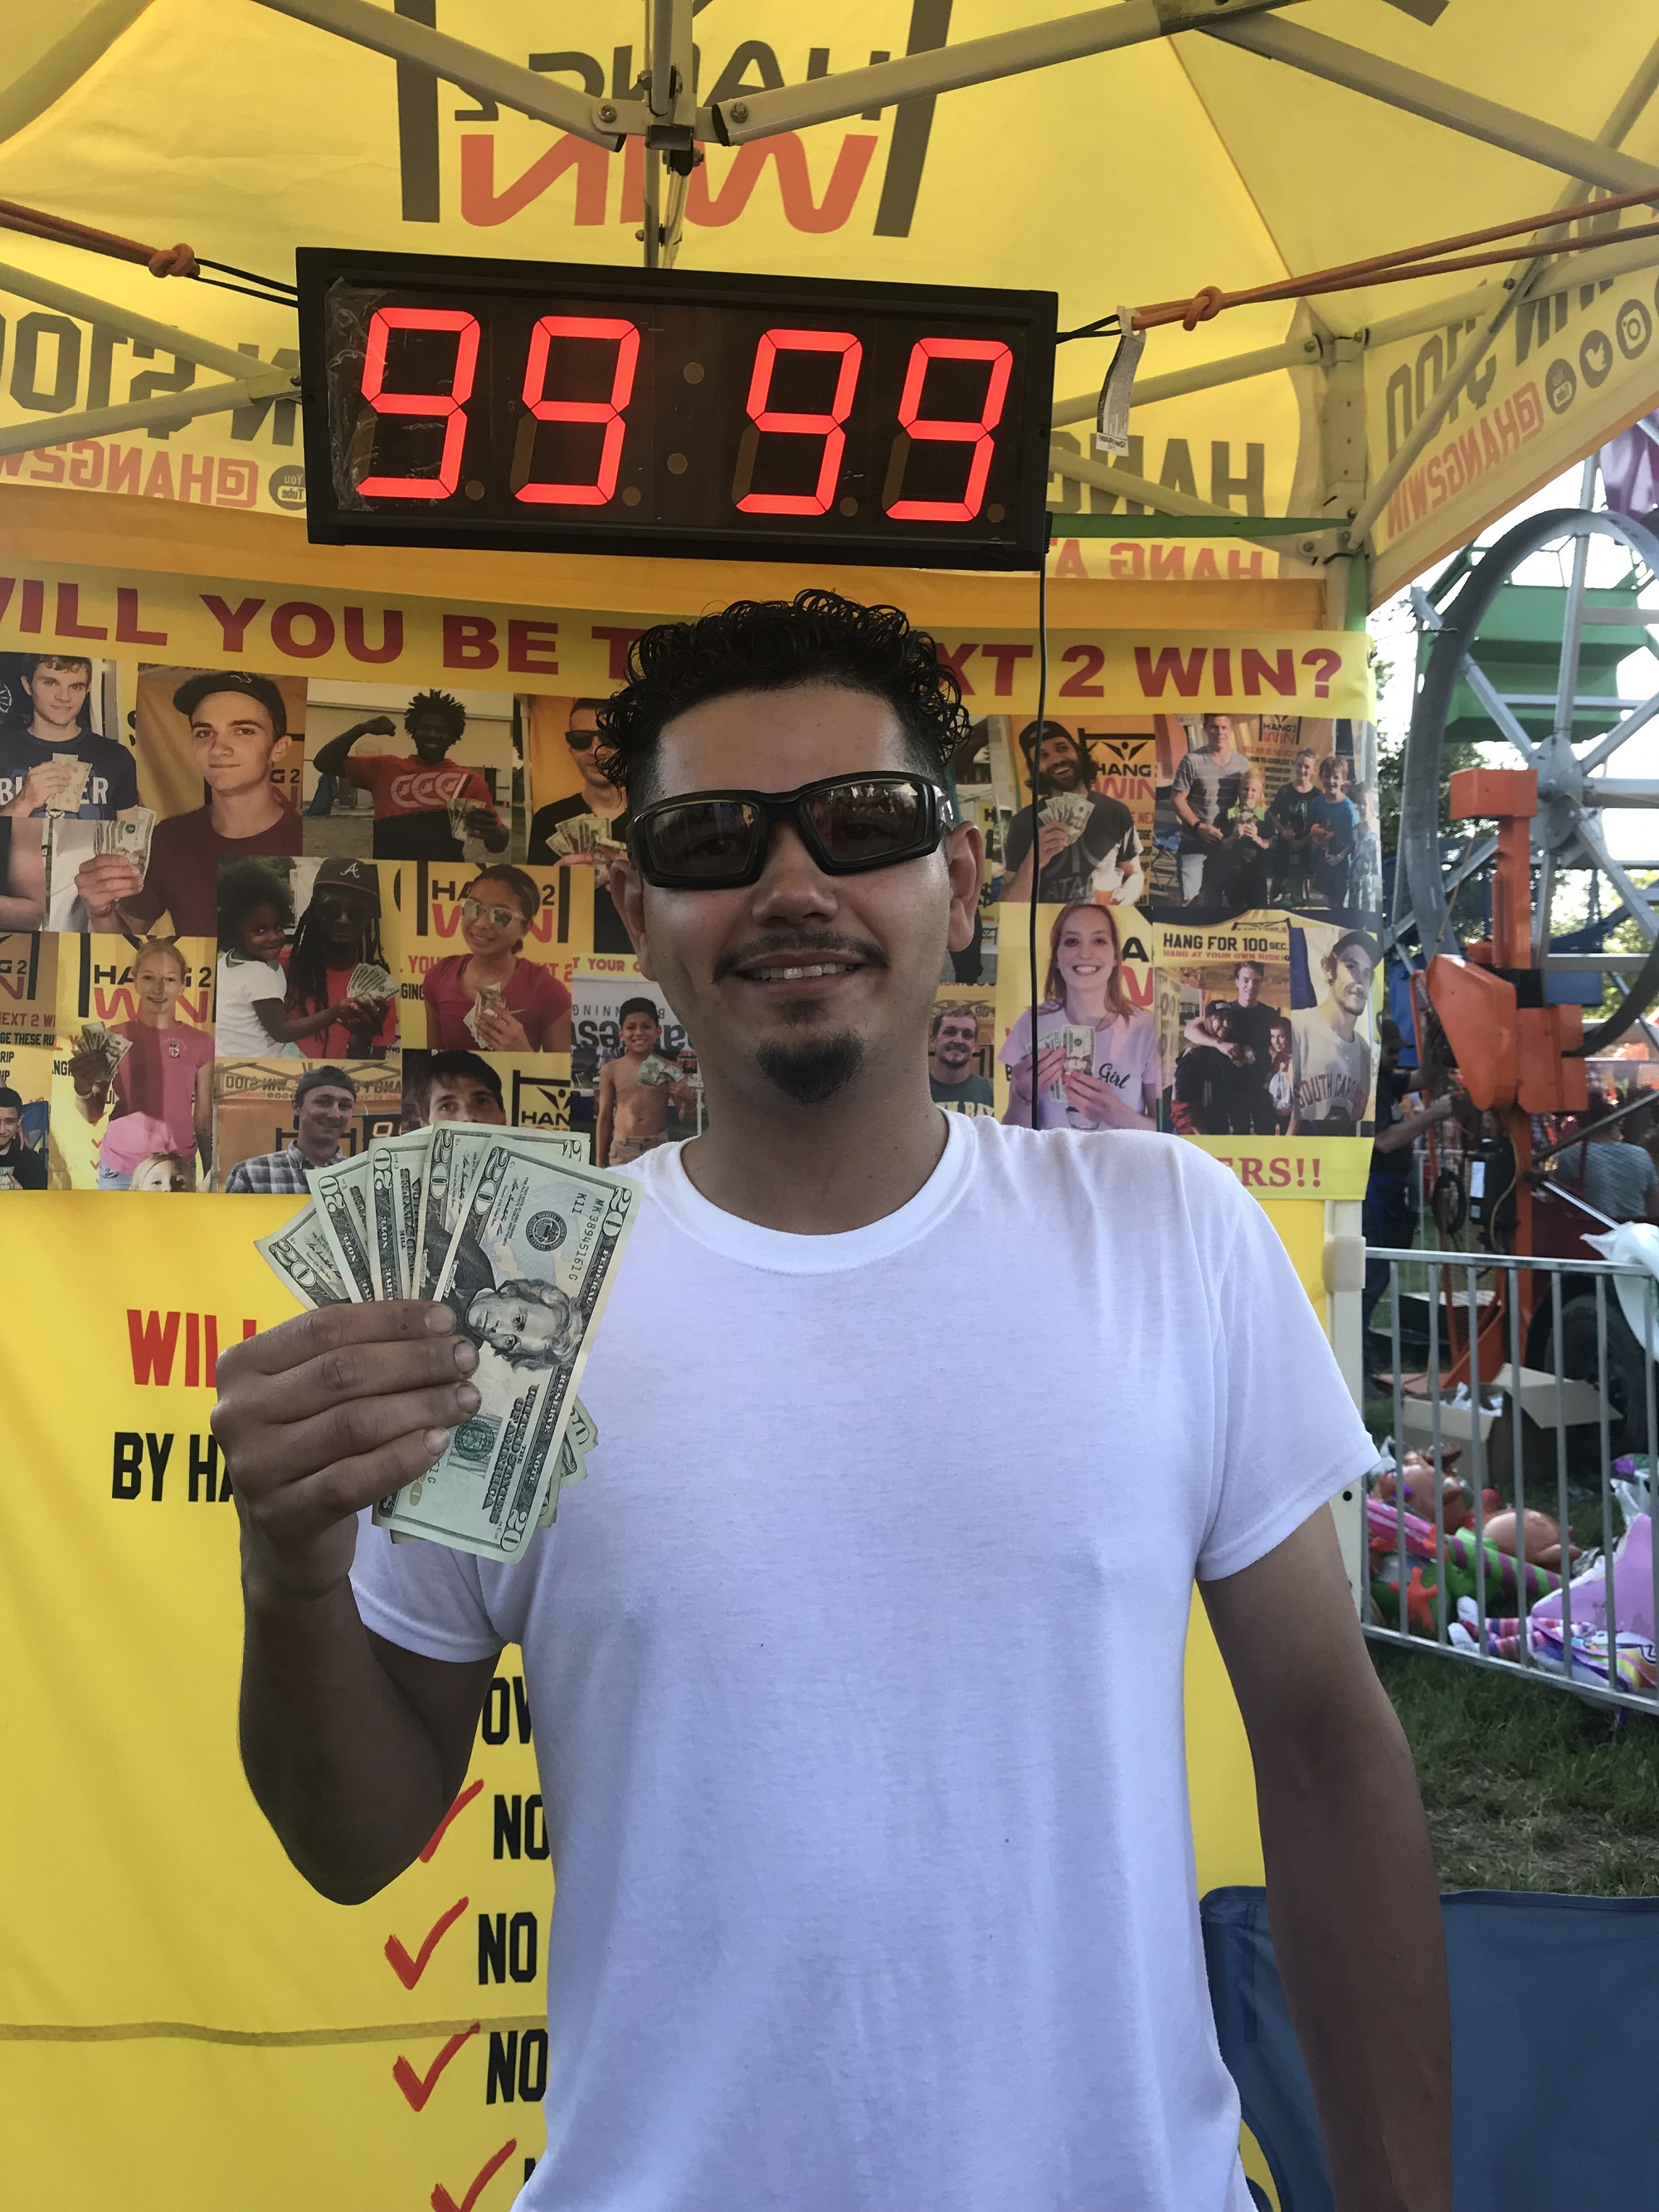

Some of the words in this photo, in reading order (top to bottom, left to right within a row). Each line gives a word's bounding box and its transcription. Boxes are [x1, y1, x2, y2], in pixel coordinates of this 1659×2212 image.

[199, 593, 404, 665] YOU
[442, 614, 559, 675] BE
[1059, 644, 1105, 698] 2
[1135, 646, 1343, 699] WIN?
[587, 958, 625, 972] YOUR
[1163, 933, 1203, 950] HANG
[1207, 936, 1238, 952] FOR
[1243, 938, 1268, 953] 100
[198, 967, 212, 987] 2
[14, 1032, 41, 1045] THESE
[1098, 1063, 1131, 1089] Girl
[112, 1431, 174, 1502] BY
[494, 1794, 551, 1860] NO
[479, 1912, 538, 1985] NO
[486, 2029, 549, 2105] NO
